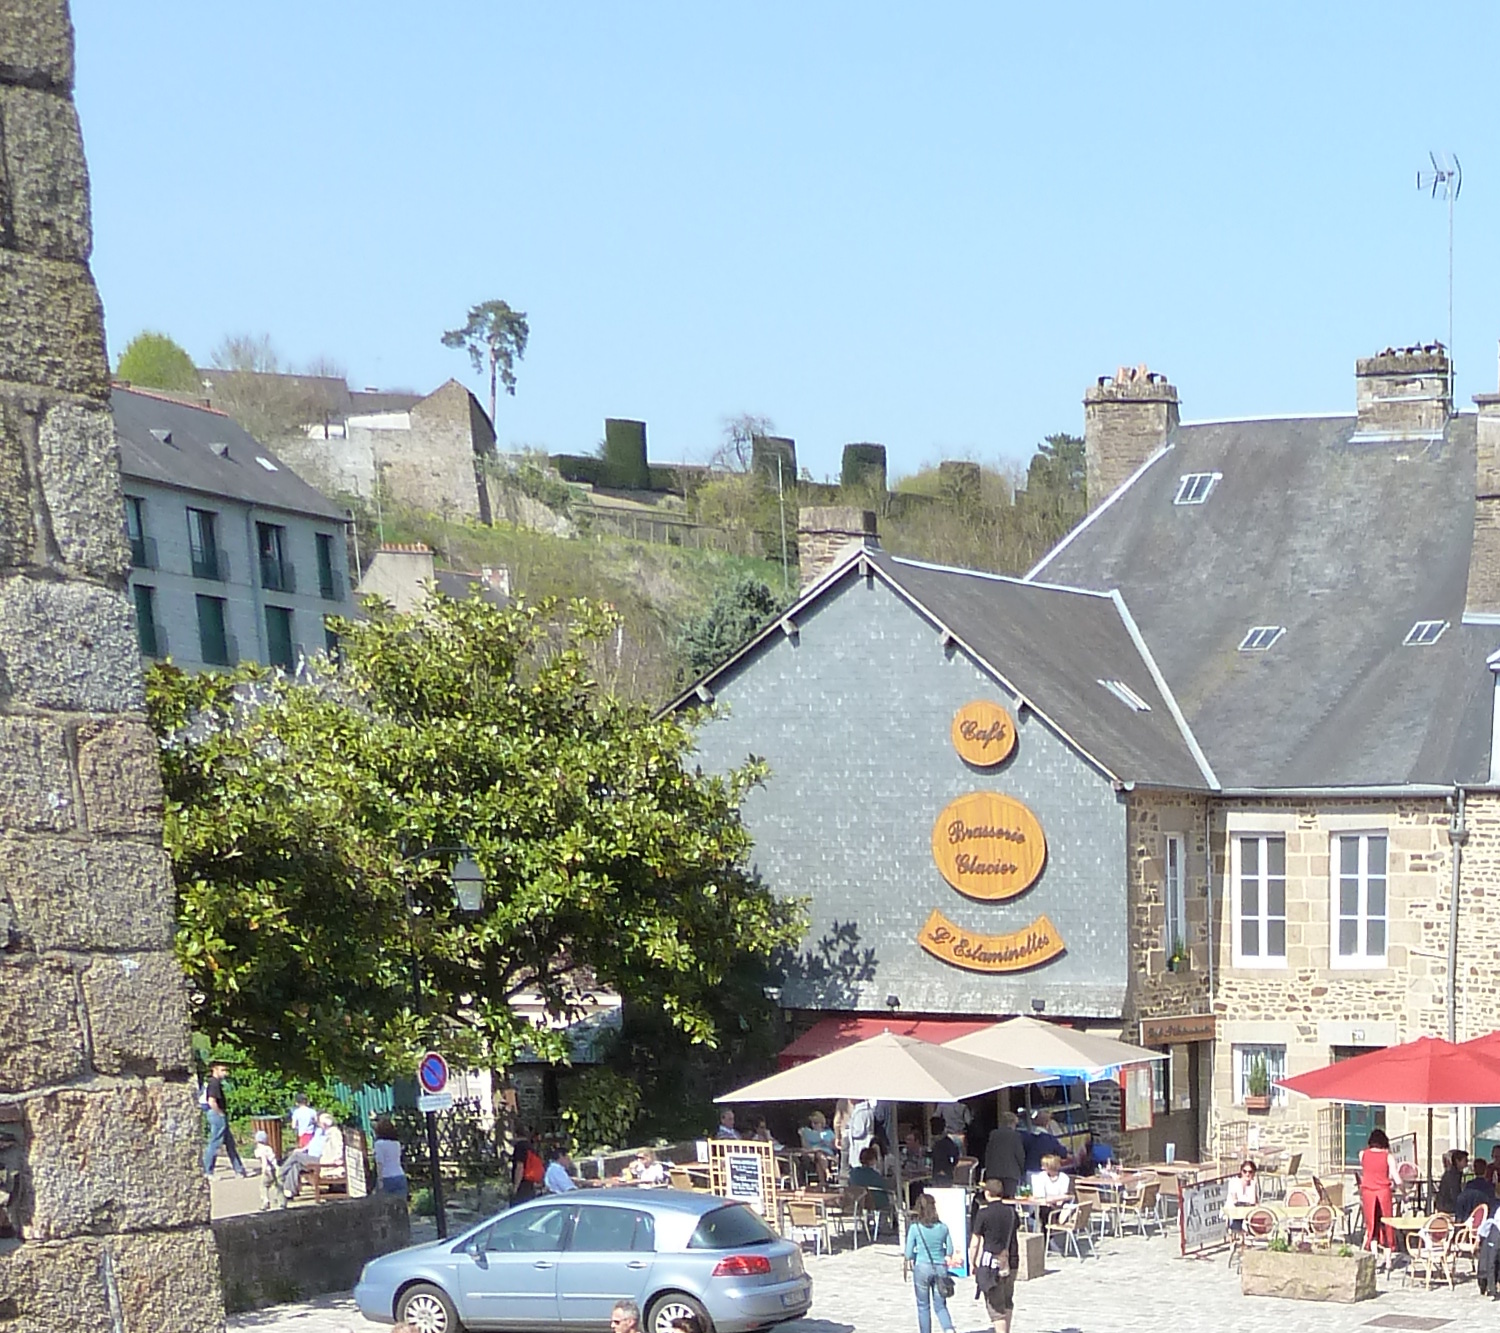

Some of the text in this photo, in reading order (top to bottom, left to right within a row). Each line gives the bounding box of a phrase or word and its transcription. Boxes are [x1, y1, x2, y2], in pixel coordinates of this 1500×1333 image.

[960, 720, 1007, 749] Café
[948, 820, 1026, 845] Brasserie
[955, 853, 1018, 875] Glacier
[1204, 1187, 1221, 1199] BAR
